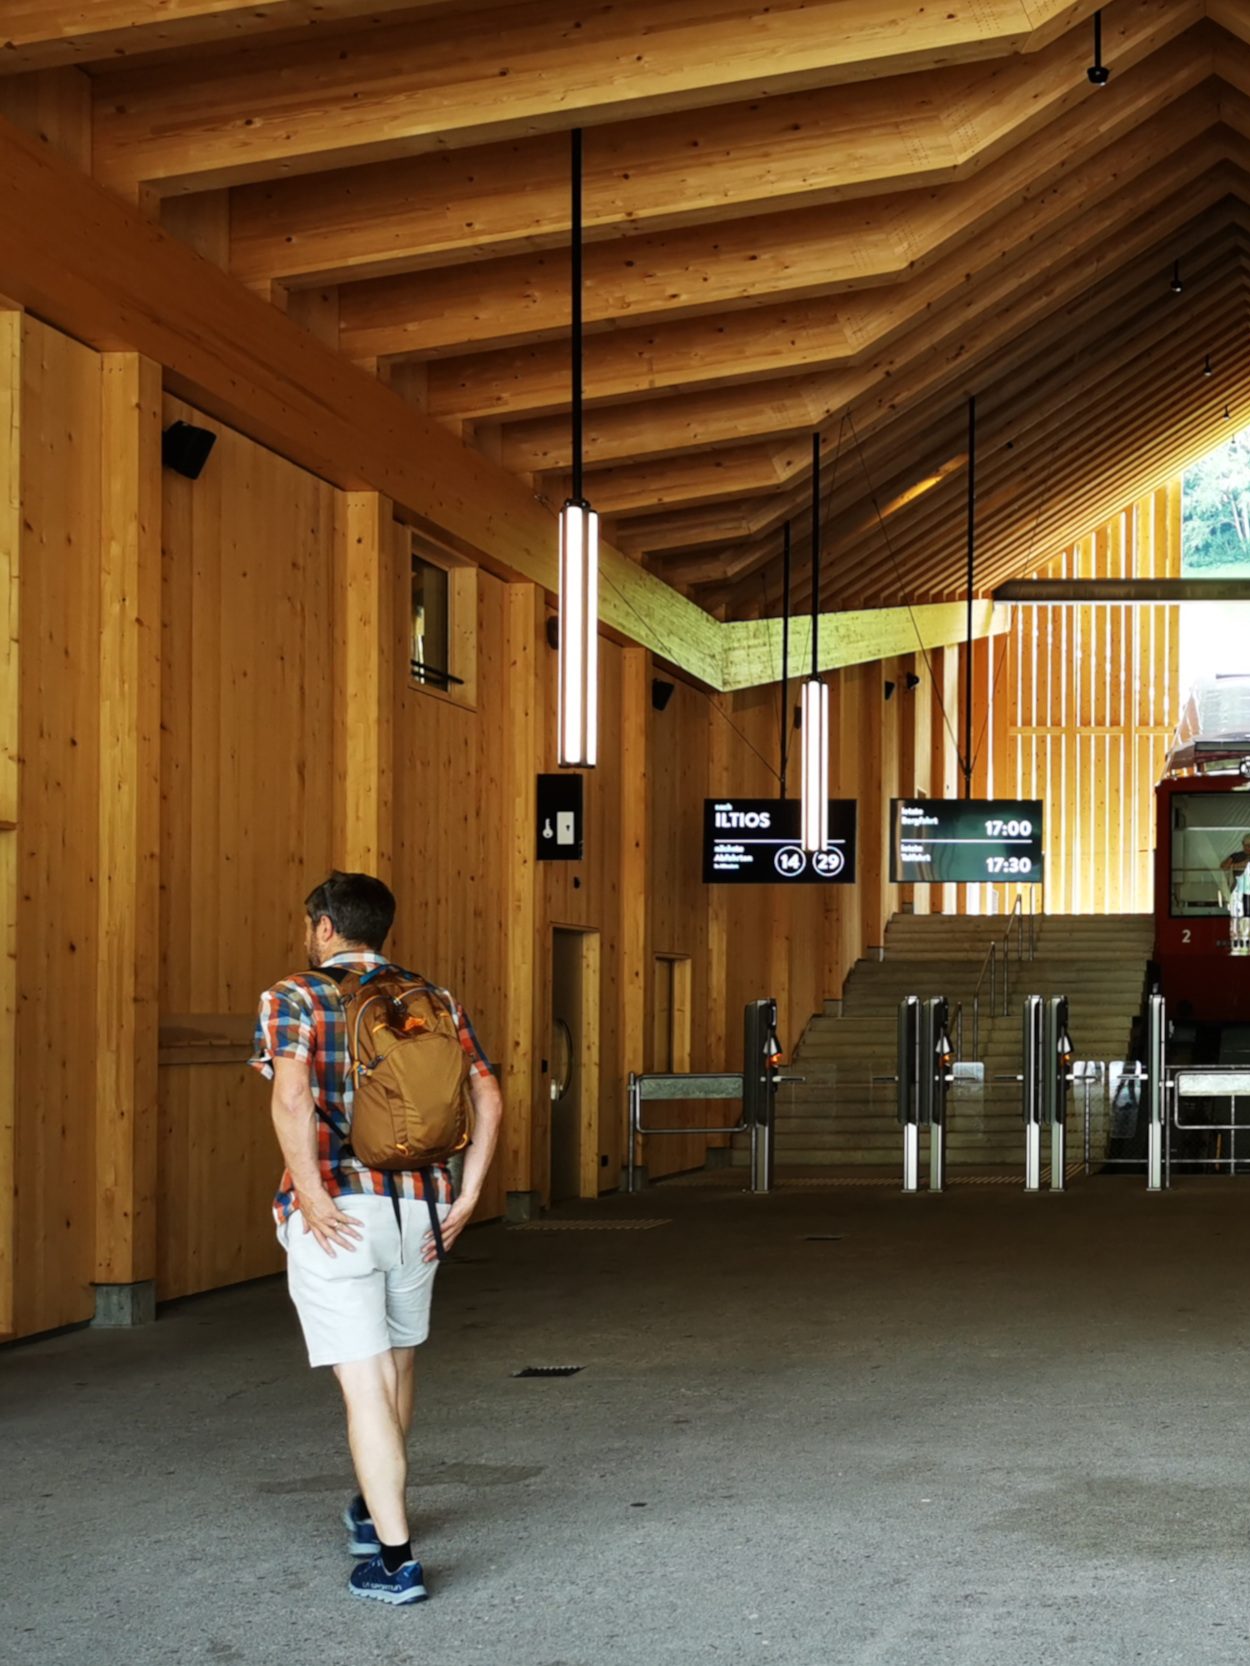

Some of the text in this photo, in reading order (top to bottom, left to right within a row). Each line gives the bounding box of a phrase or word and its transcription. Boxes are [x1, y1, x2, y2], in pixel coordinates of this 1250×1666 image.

[715, 812, 771, 828] ILTIOS
[985, 820, 1032, 836] 17:00
[780, 853, 840, 870] 14 29
[986, 857, 1032, 873] 17:30
[1182, 929, 1191, 943] 2
